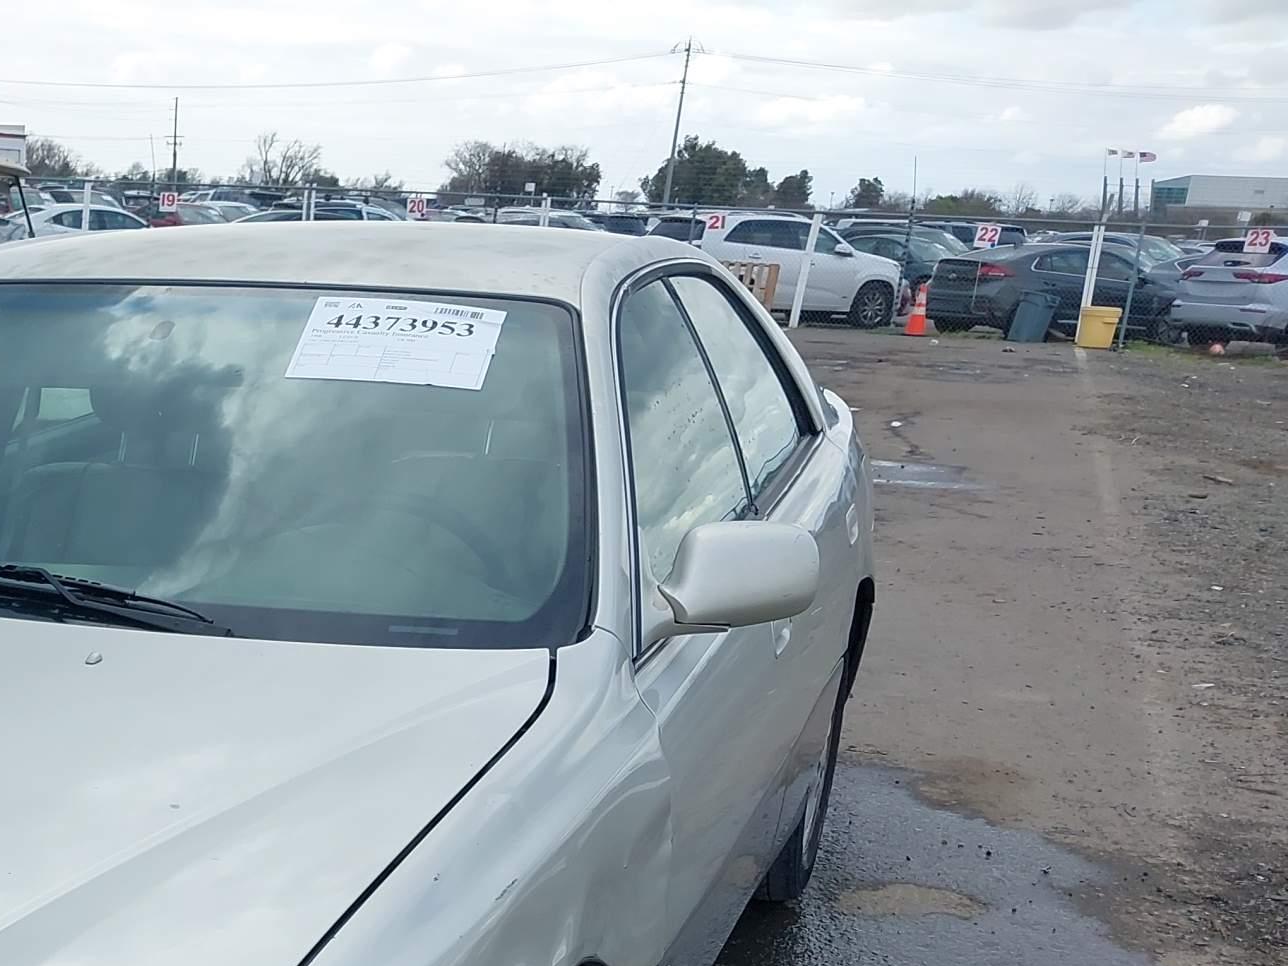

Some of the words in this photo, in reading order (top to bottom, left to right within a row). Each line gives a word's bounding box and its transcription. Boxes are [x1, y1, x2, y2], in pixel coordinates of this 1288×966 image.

[160, 193, 175, 206] 19
[408, 199, 425, 213] 20
[707, 215, 725, 229] 21
[977, 227, 998, 243] 22
[1248, 230, 1270, 247] 23
[325, 314, 475, 337] 44373953
